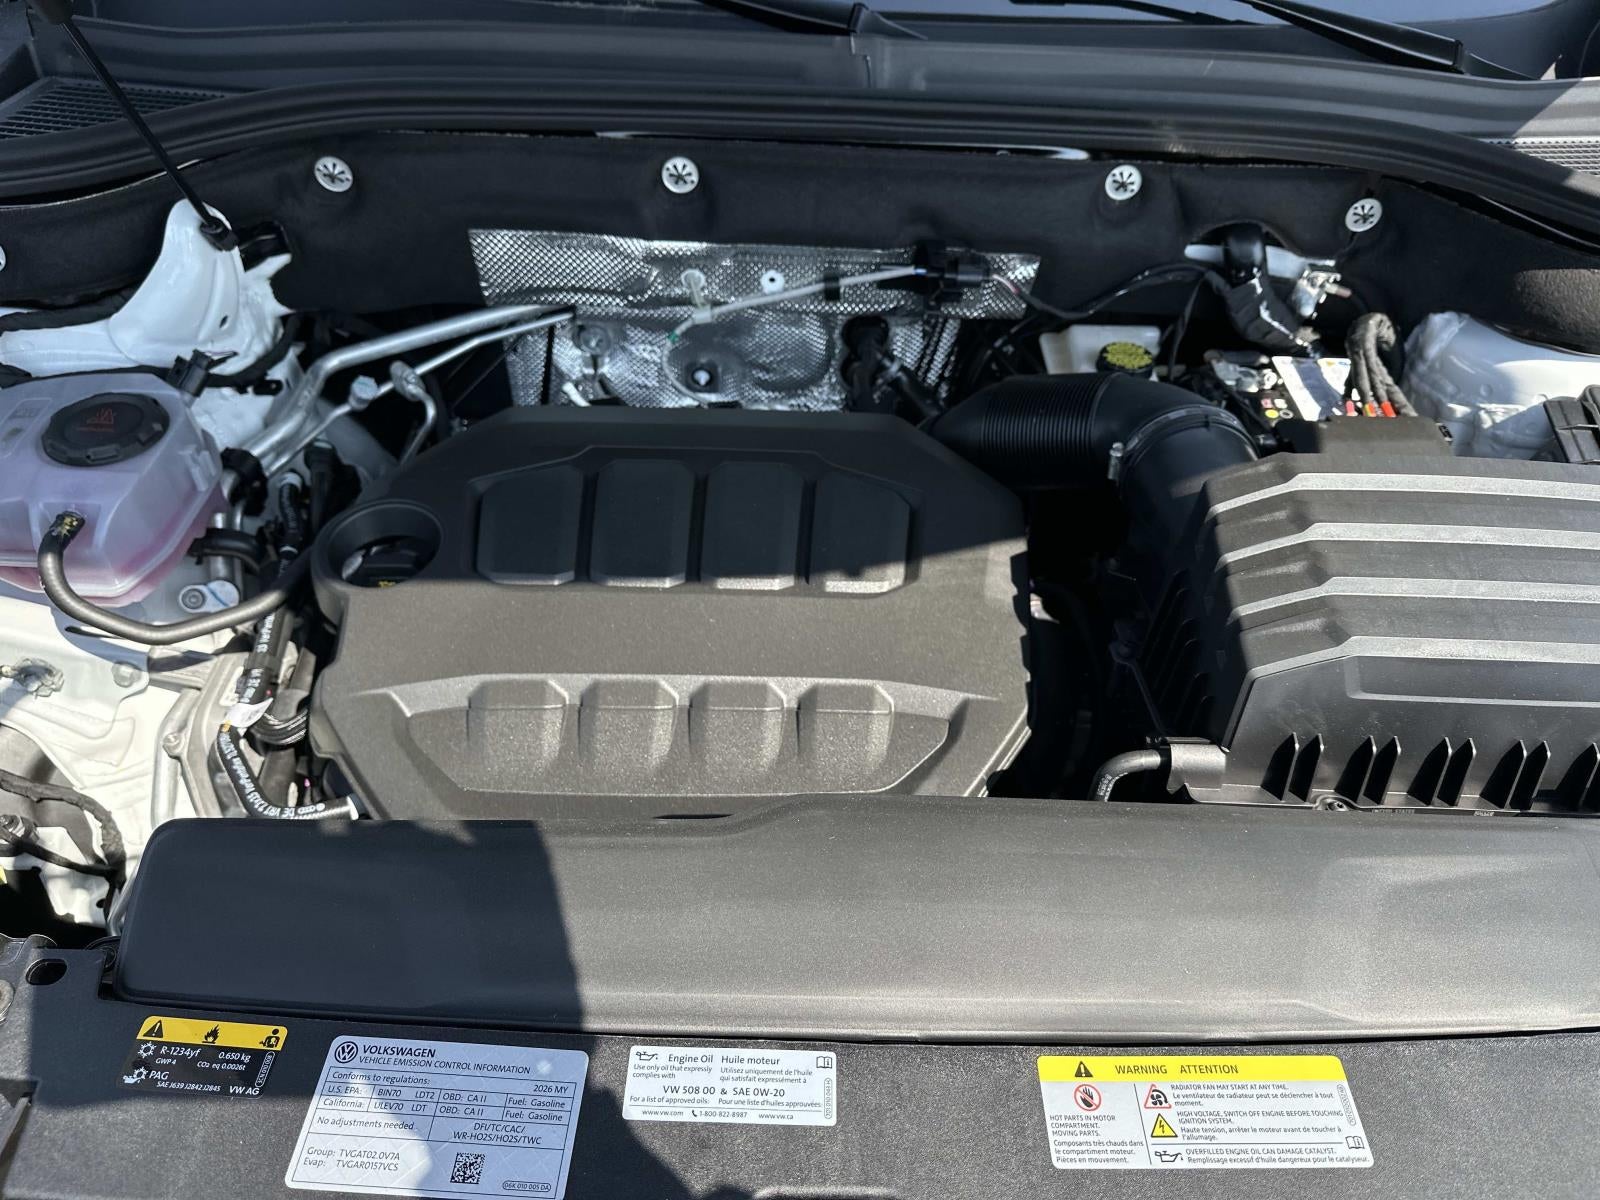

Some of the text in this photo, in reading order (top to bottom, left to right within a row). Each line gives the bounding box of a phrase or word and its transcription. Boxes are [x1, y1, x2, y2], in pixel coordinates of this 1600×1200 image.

[160, 1046, 201, 1058] R-1234yf
[363, 1044, 436, 1058] VOLKSWAGEN
[219, 1052, 251, 1063] 0.650 kg
[668, 1054, 713, 1064] Engine Oil
[722, 1056, 780, 1065] Huile moteur
[222, 1063, 246, 1071] 0.0026t
[360, 1056, 531, 1074] VEHICLE EMISSION CONTROL INFORMATION
[646, 1064, 660, 1072] only
[684, 1066, 712, 1074] expressly
[1115, 1064, 1239, 1075] WARNING ATTENTION
[149, 1070, 169, 1080] PAG
[333, 1071, 430, 1085] Conforms to regulations:
[745, 1068, 783, 1077] uniquement
[229, 1086, 260, 1096] VW AG
[378, 1089, 435, 1100] BIN70 LDT2
[534, 1084, 569, 1094] 2026 MY
[663, 1085, 680, 1094] VW
[682, 1086, 700, 1095] 508
[702, 1086, 716, 1095] 00
[733, 1088, 751, 1096] SAE
[753, 1088, 786, 1097] 0W-20
[443, 1092, 479, 1102] OBD: CA
[666, 1097, 696, 1105] approved
[323, 1098, 364, 1109] California:
[374, 1102, 427, 1112] ULEV70 LDT
[508, 1097, 566, 1109] Fuel: Gasoline
[440, 1106, 476, 1115] OBD: CA
[505, 1110, 563, 1122] Fuel: Gasoline
[330, 1117, 382, 1128] adjustments
[474, 1122, 526, 1134] DFI/TC/CAC/
[453, 1131, 542, 1145] WR-HO2S/HO2S/TWC
[1054, 1140, 1092, 1148] Composants
[307, 1146, 400, 1161] Group: TVGAT02.0V7A
[304, 1157, 326, 1167] Evap:
